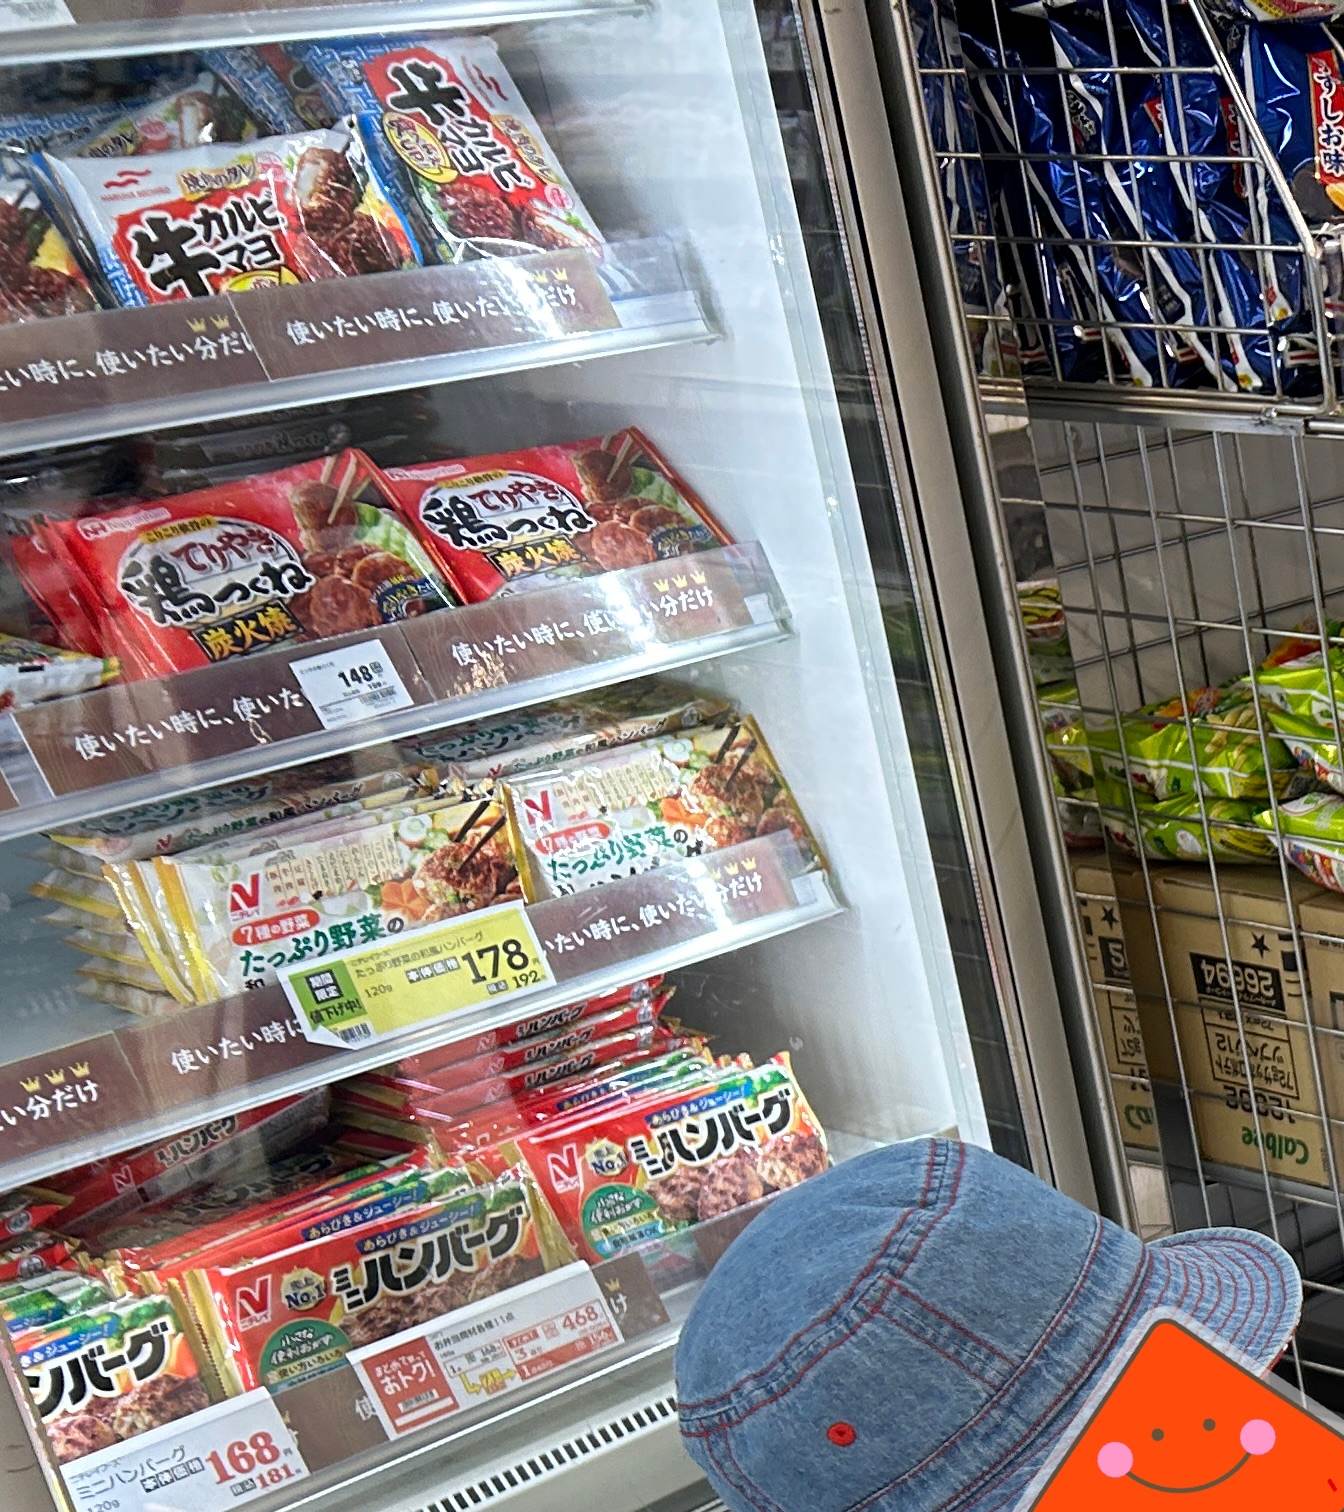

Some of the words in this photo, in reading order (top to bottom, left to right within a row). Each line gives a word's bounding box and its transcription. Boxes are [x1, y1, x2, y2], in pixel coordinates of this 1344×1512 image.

[194, 196, 282, 243] カルビ
[215, 234, 282, 271] マヨ
[171, 527, 280, 573] てりやき
[496, 538, 581, 577] 炭火焼
[201, 604, 297, 660] 炭火焼
[337, 664, 374, 689] 148
[240, 914, 404, 978] たっぷり野菜の
[461, 938, 531, 985] 178
[511, 969, 540, 990] 192
[1242, 1126, 1310, 1166] Calbee
[284, 1283, 326, 1311] No.1
[561, 1306, 600, 1332] 468
[76, 1444, 188, 1500] ミニハンバーグ
[204, 1430, 283, 1486] 168
[255, 1463, 297, 1490] 181
